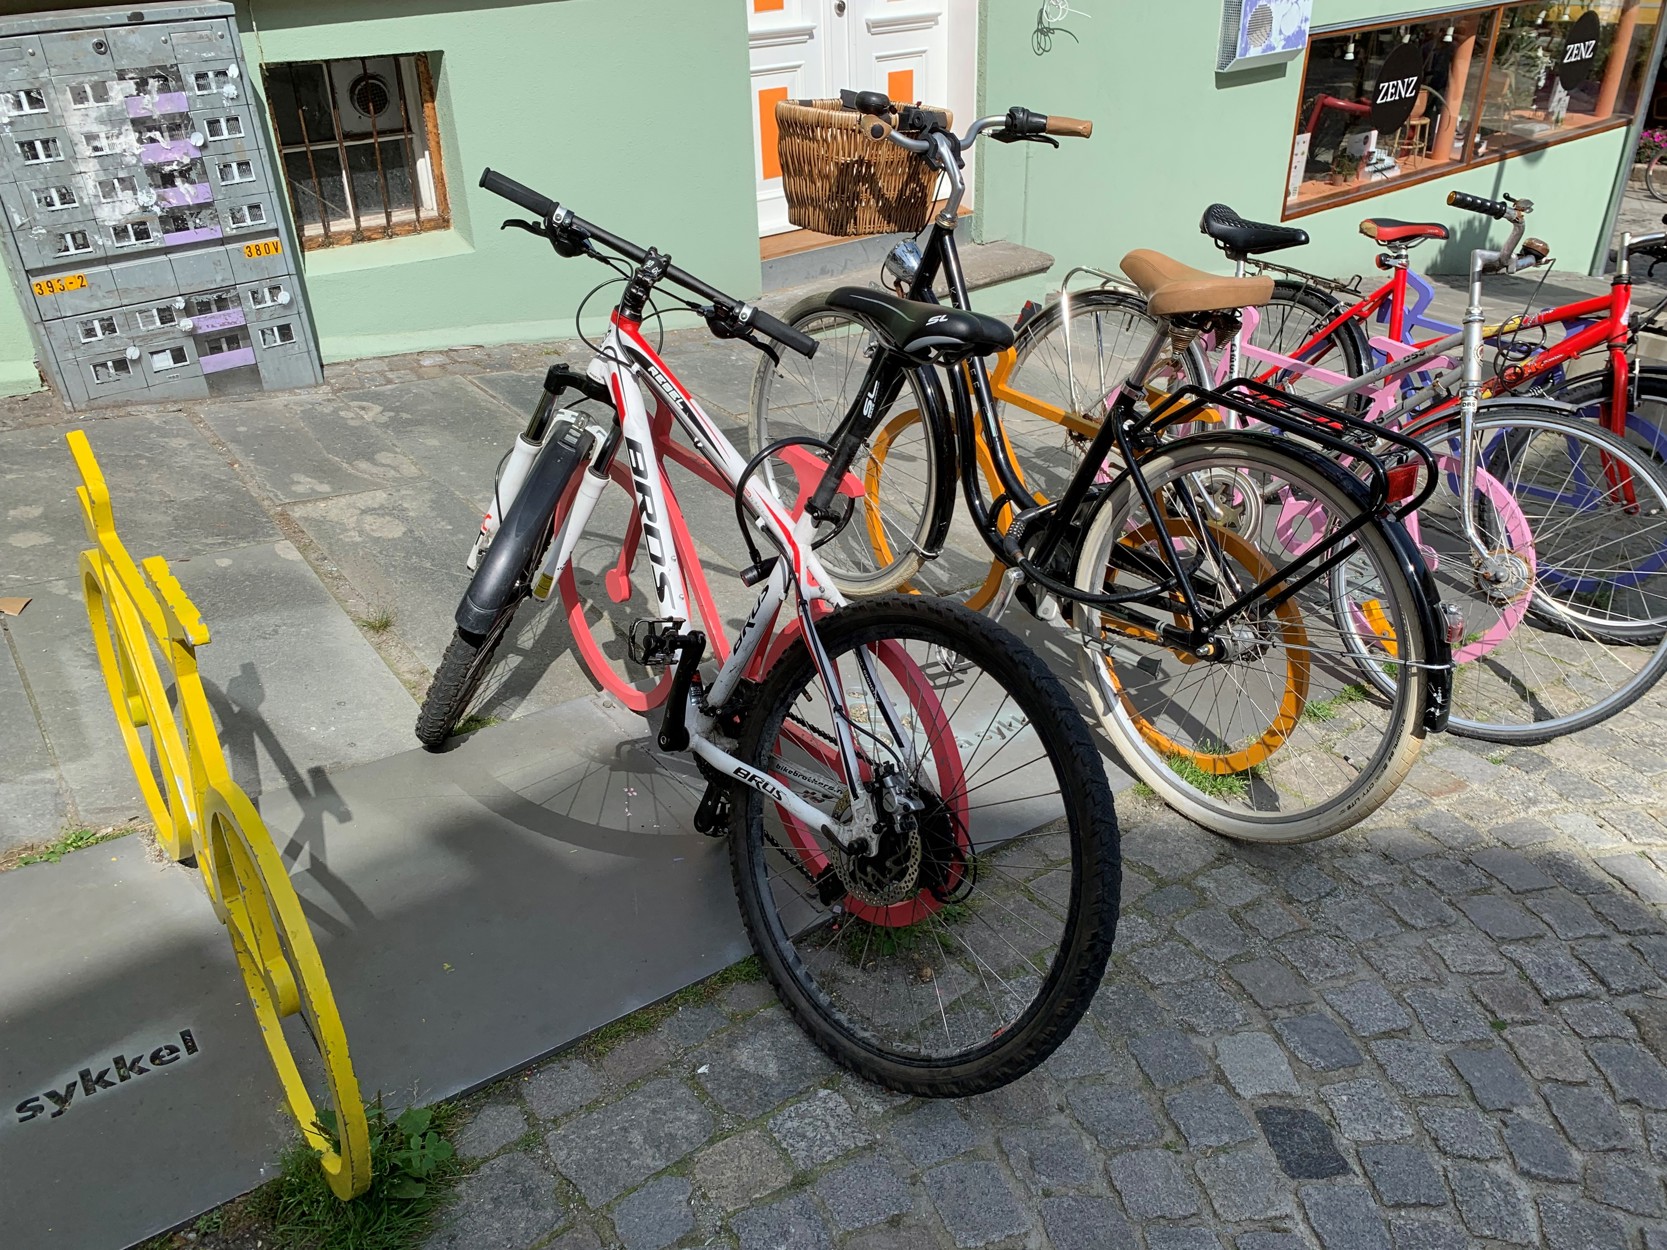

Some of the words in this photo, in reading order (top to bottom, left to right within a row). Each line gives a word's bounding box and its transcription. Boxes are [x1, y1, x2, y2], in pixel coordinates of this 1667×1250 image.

[1563, 40, 1596, 63] ZENZ
[1376, 76, 1418, 104] ZENZ
[245, 241, 279, 258] 380V
[35, 275, 87, 296] 393-2
[925, 314, 948, 326] SL
[647, 365, 684, 409] REBEL
[775, 763, 844, 795] bikebrothers.n
[1362, 782, 1375, 798] CITY
[15, 1029, 198, 1123] sykkel
